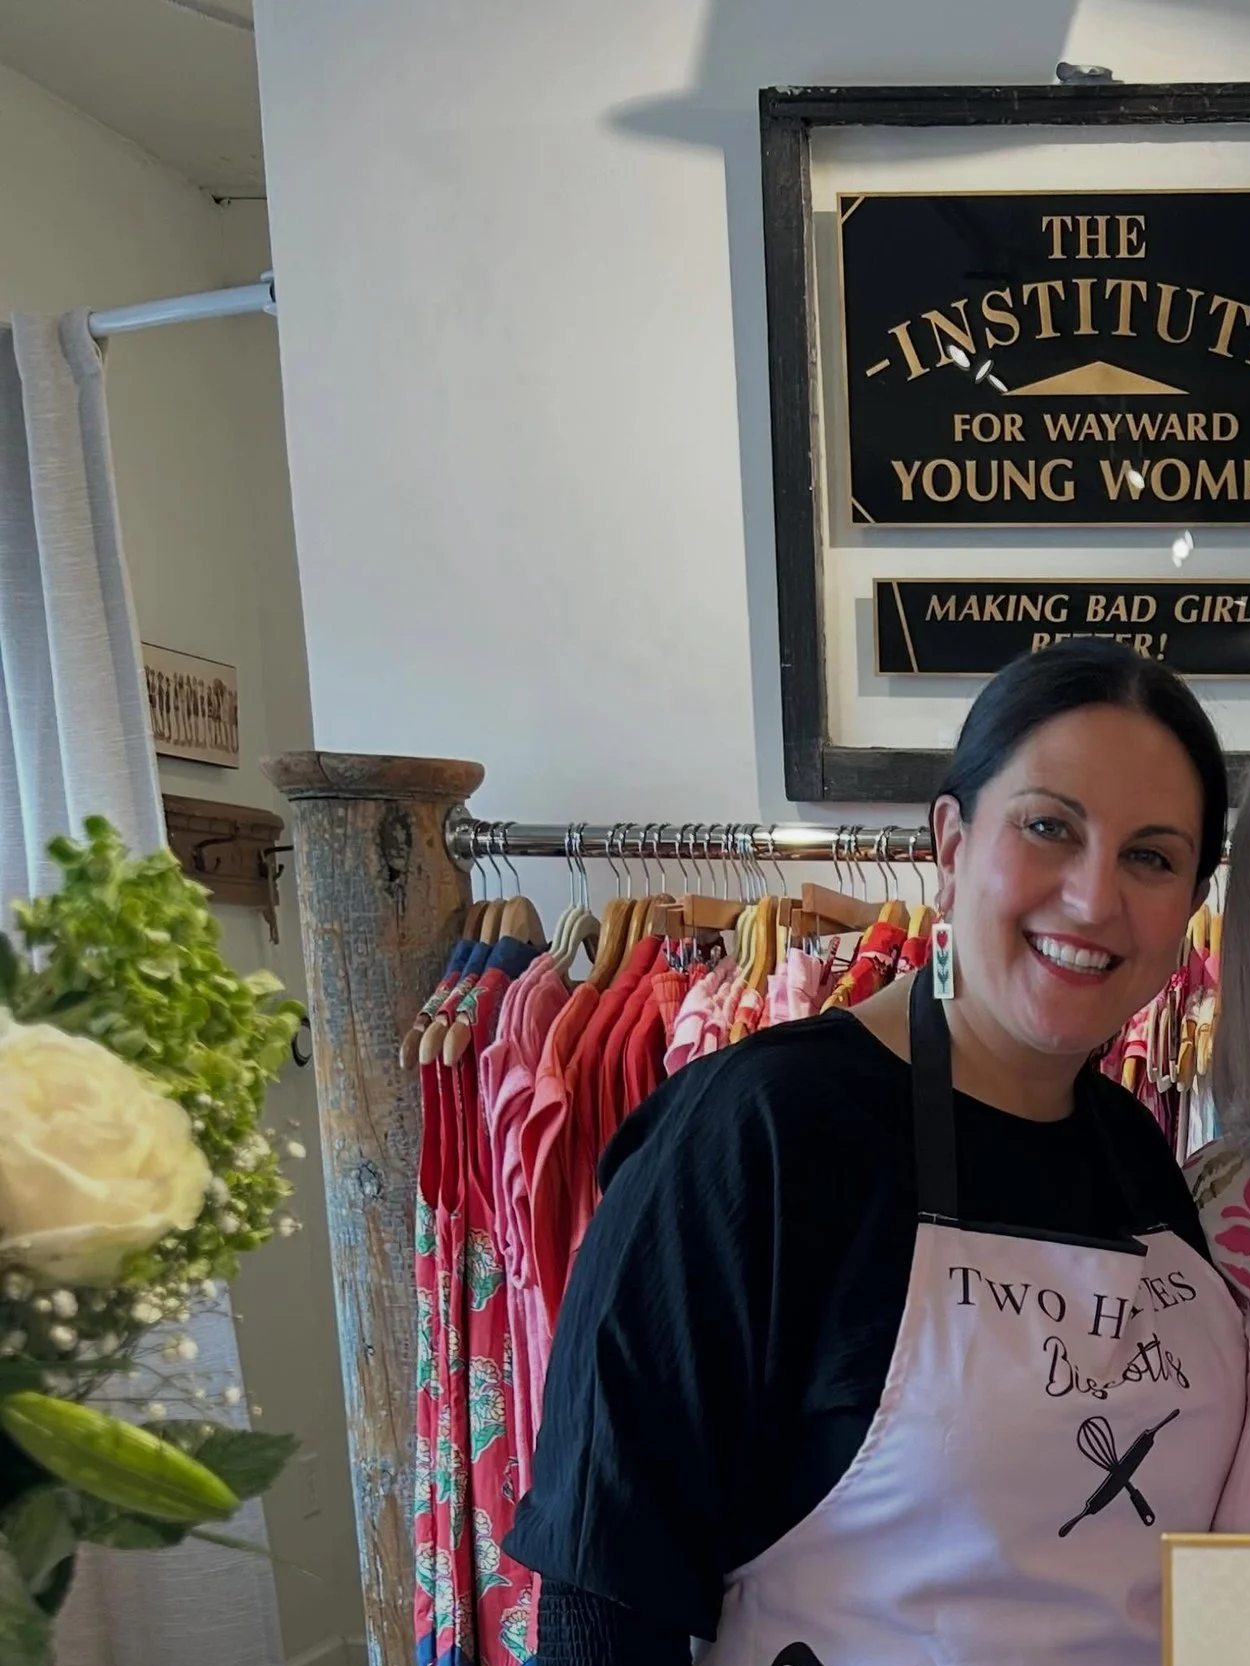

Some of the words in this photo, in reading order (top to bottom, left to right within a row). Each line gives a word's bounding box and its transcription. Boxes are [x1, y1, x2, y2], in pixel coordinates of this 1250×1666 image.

[1042, 215, 1146, 259] THE
[954, 413, 1025, 442] FOR
[1044, 413, 1239, 442] WAYWARD
[891, 458, 1075, 501] YOUNG
[925, 594, 1069, 623] MAKING
[1086, 595, 1156, 623] BAD
[949, 1266, 1066, 1323] TWO
